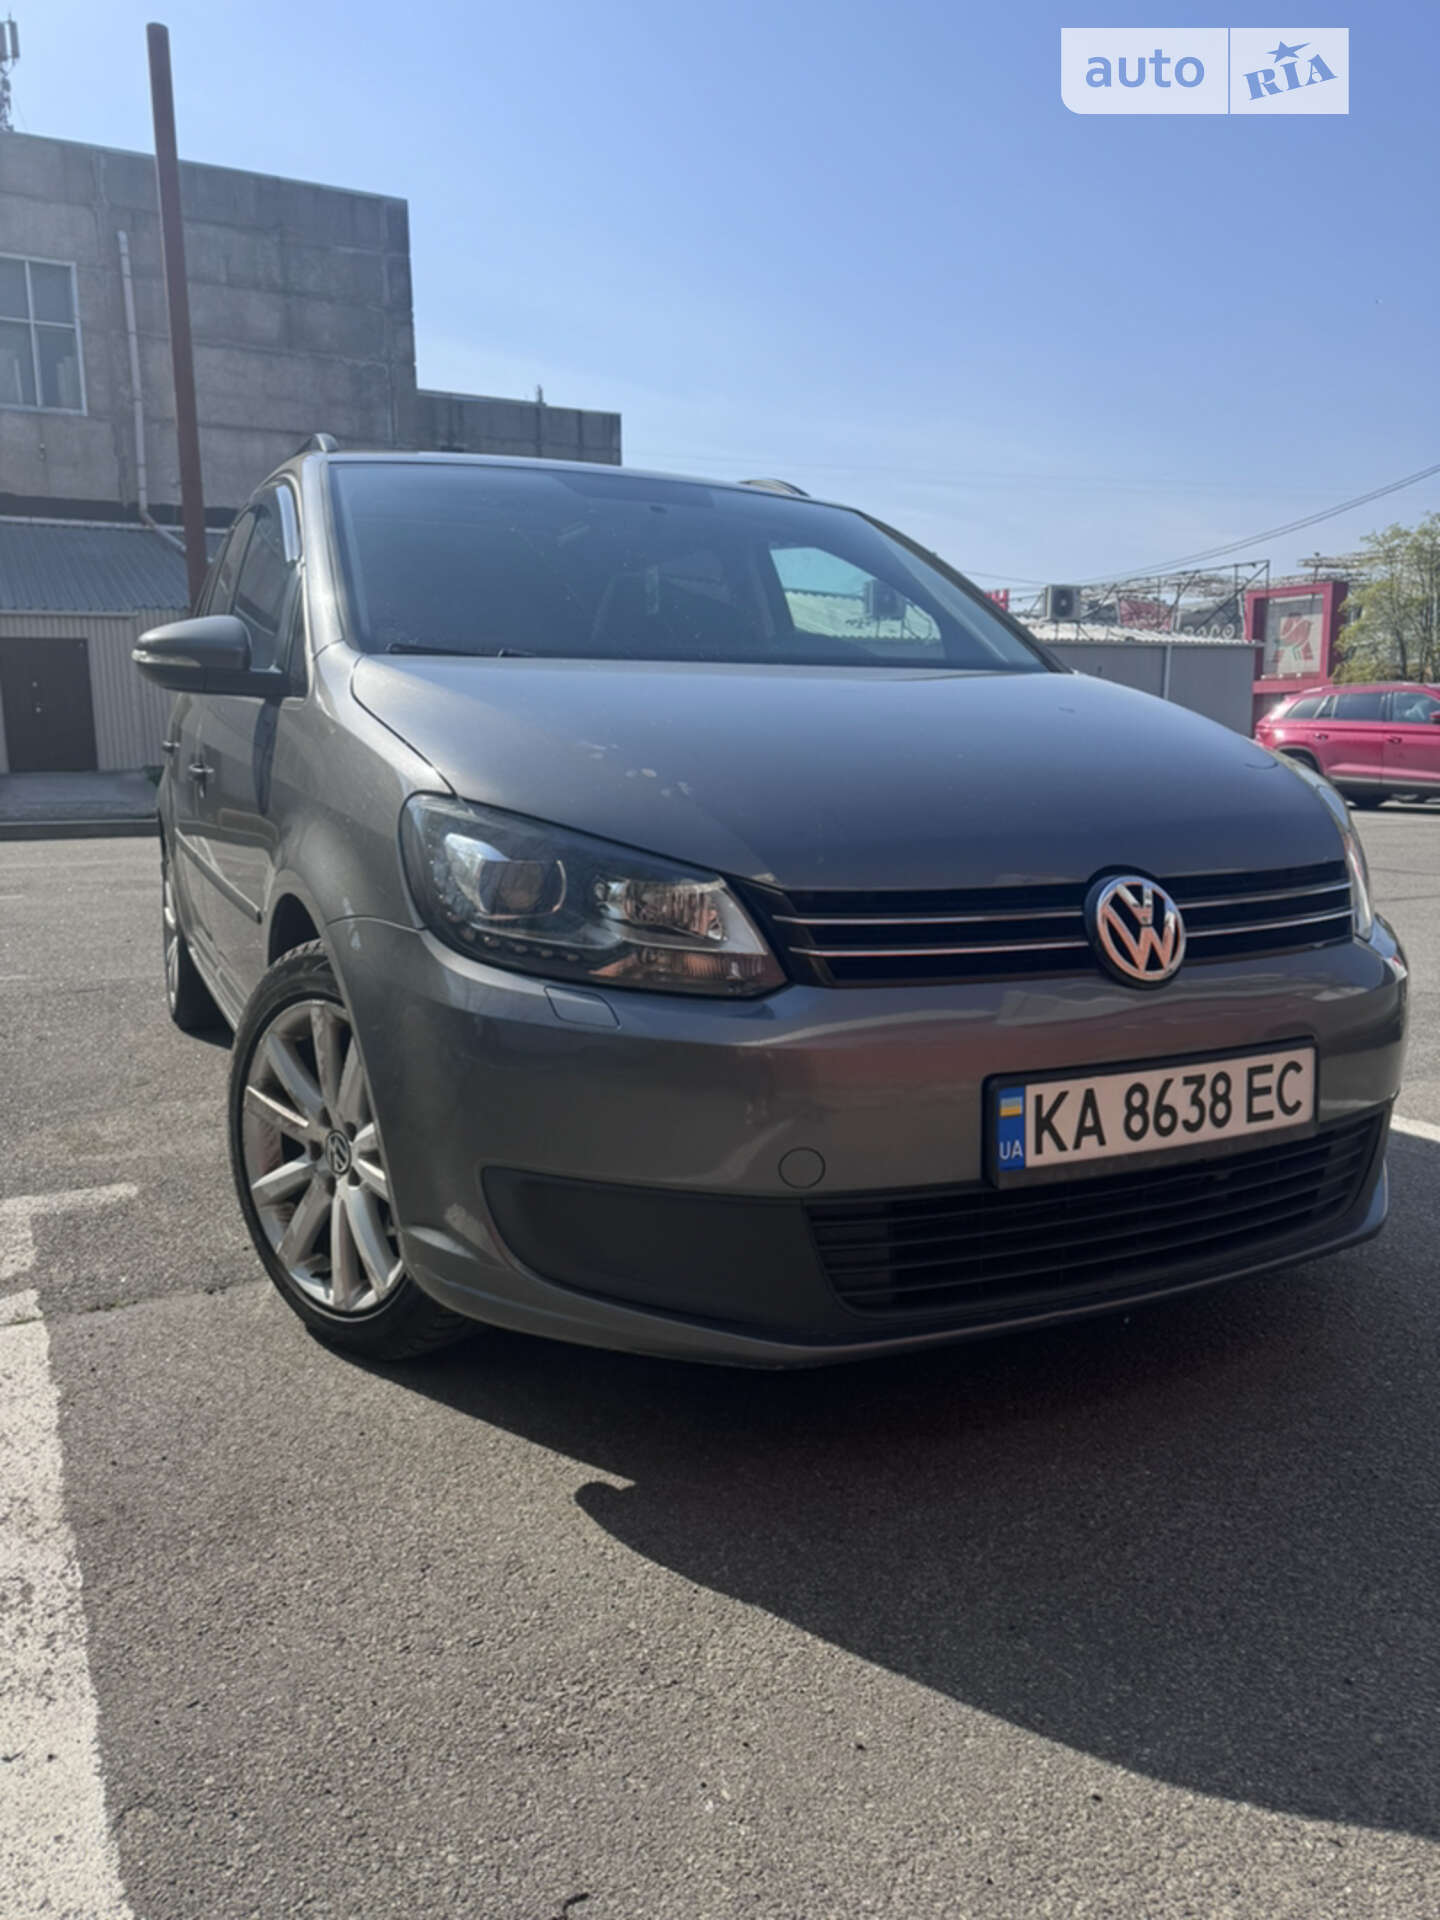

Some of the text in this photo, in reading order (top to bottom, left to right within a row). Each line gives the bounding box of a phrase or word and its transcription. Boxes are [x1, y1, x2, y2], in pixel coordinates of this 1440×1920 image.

[1034, 1060, 1304, 1155] KA 8638 EC
[999, 1140, 1024, 1161] UA
